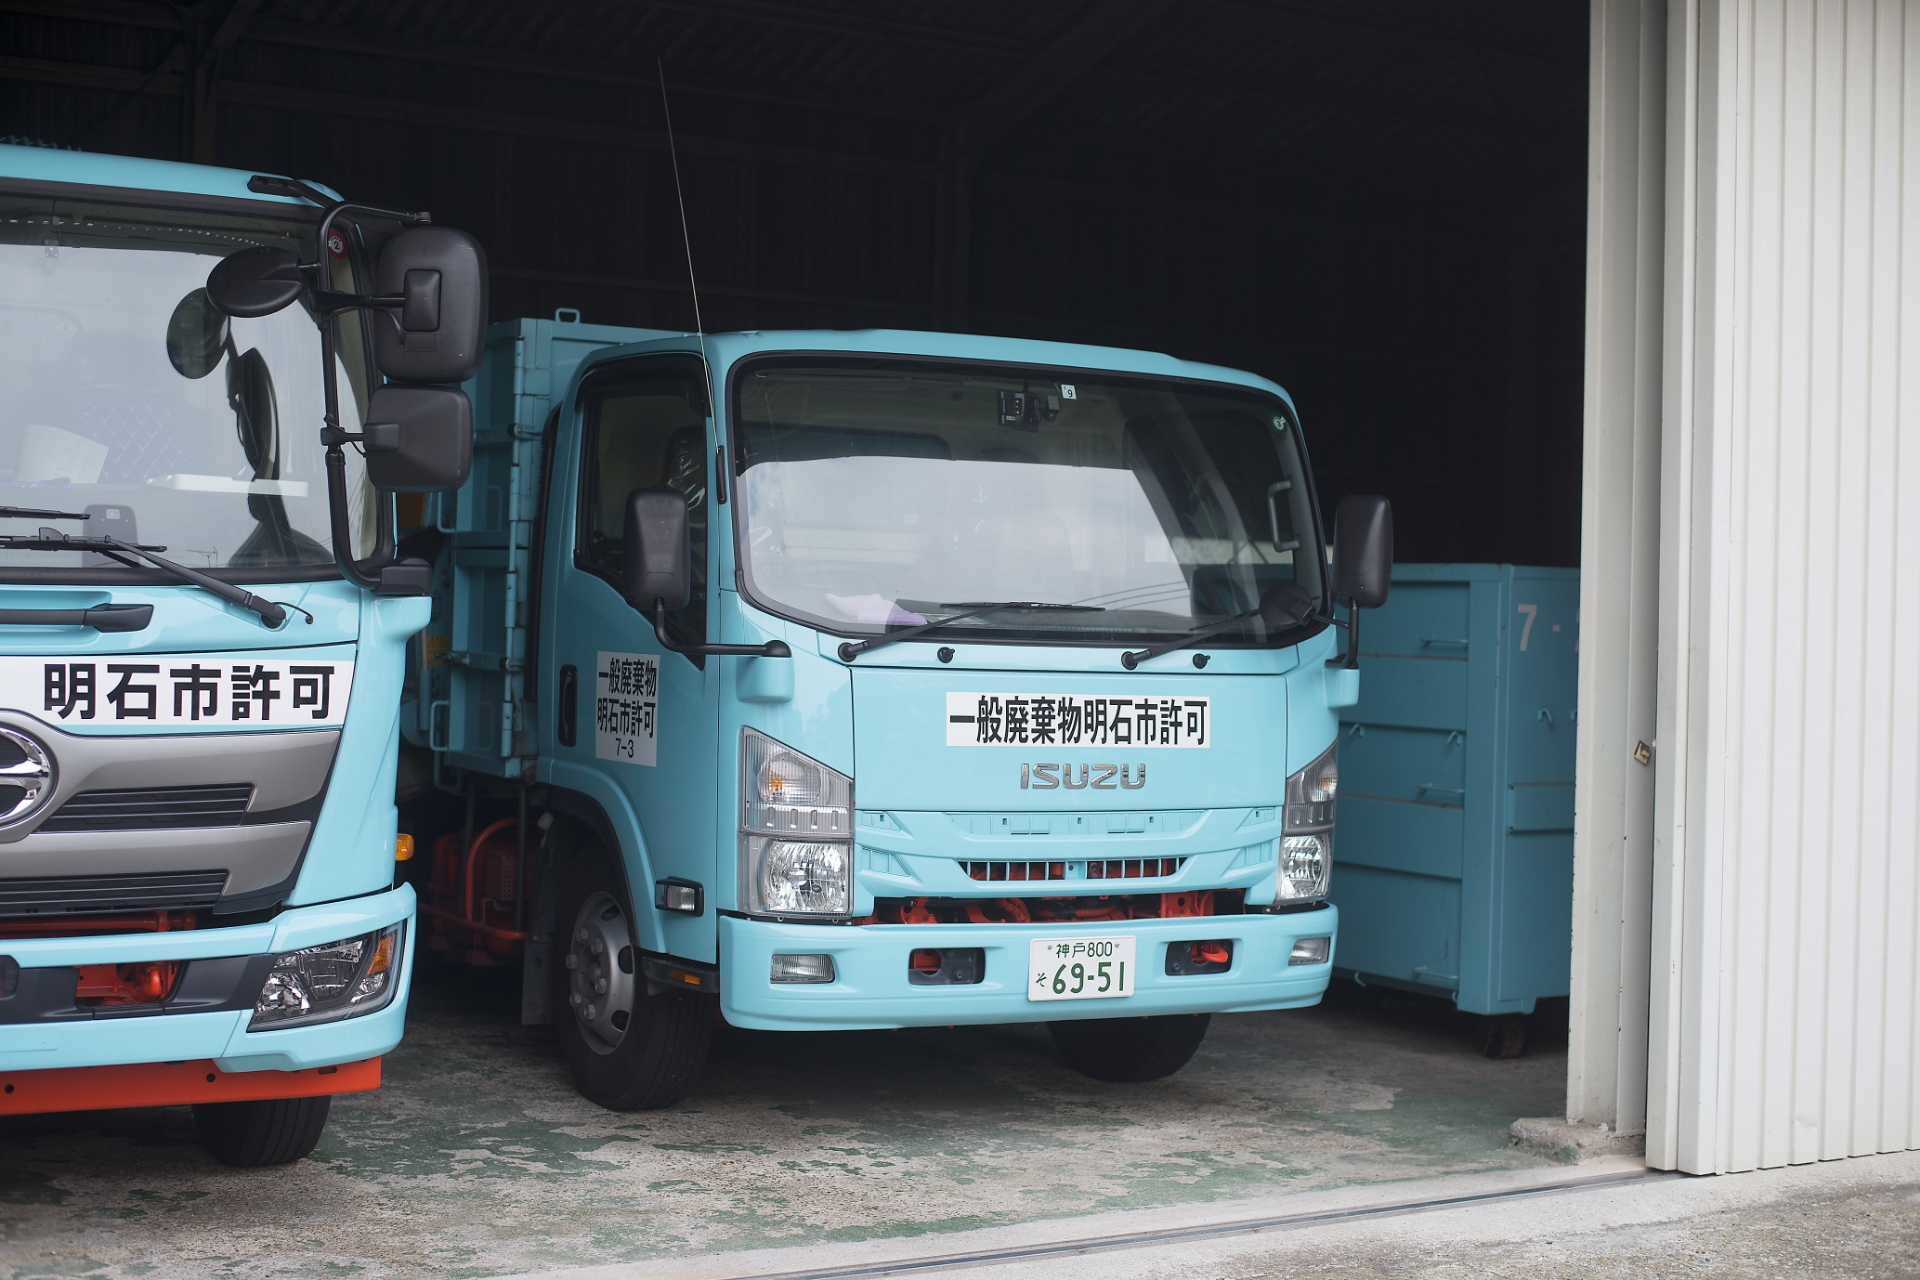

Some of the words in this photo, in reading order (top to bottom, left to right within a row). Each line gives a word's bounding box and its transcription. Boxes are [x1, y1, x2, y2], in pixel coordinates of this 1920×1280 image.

[1067, 389, 1073, 398] 9
[44, 663, 335, 720] 明石市許可
[598, 657, 657, 697] 一般廃棄物
[597, 698, 656, 739] 明石市許可
[949, 695, 1208, 746] 一般廃棄物明石市許可
[615, 737, 634, 758] 7-3
[1020, 763, 1146, 789] ISUZU
[1052, 961, 1125, 995] 69-51
